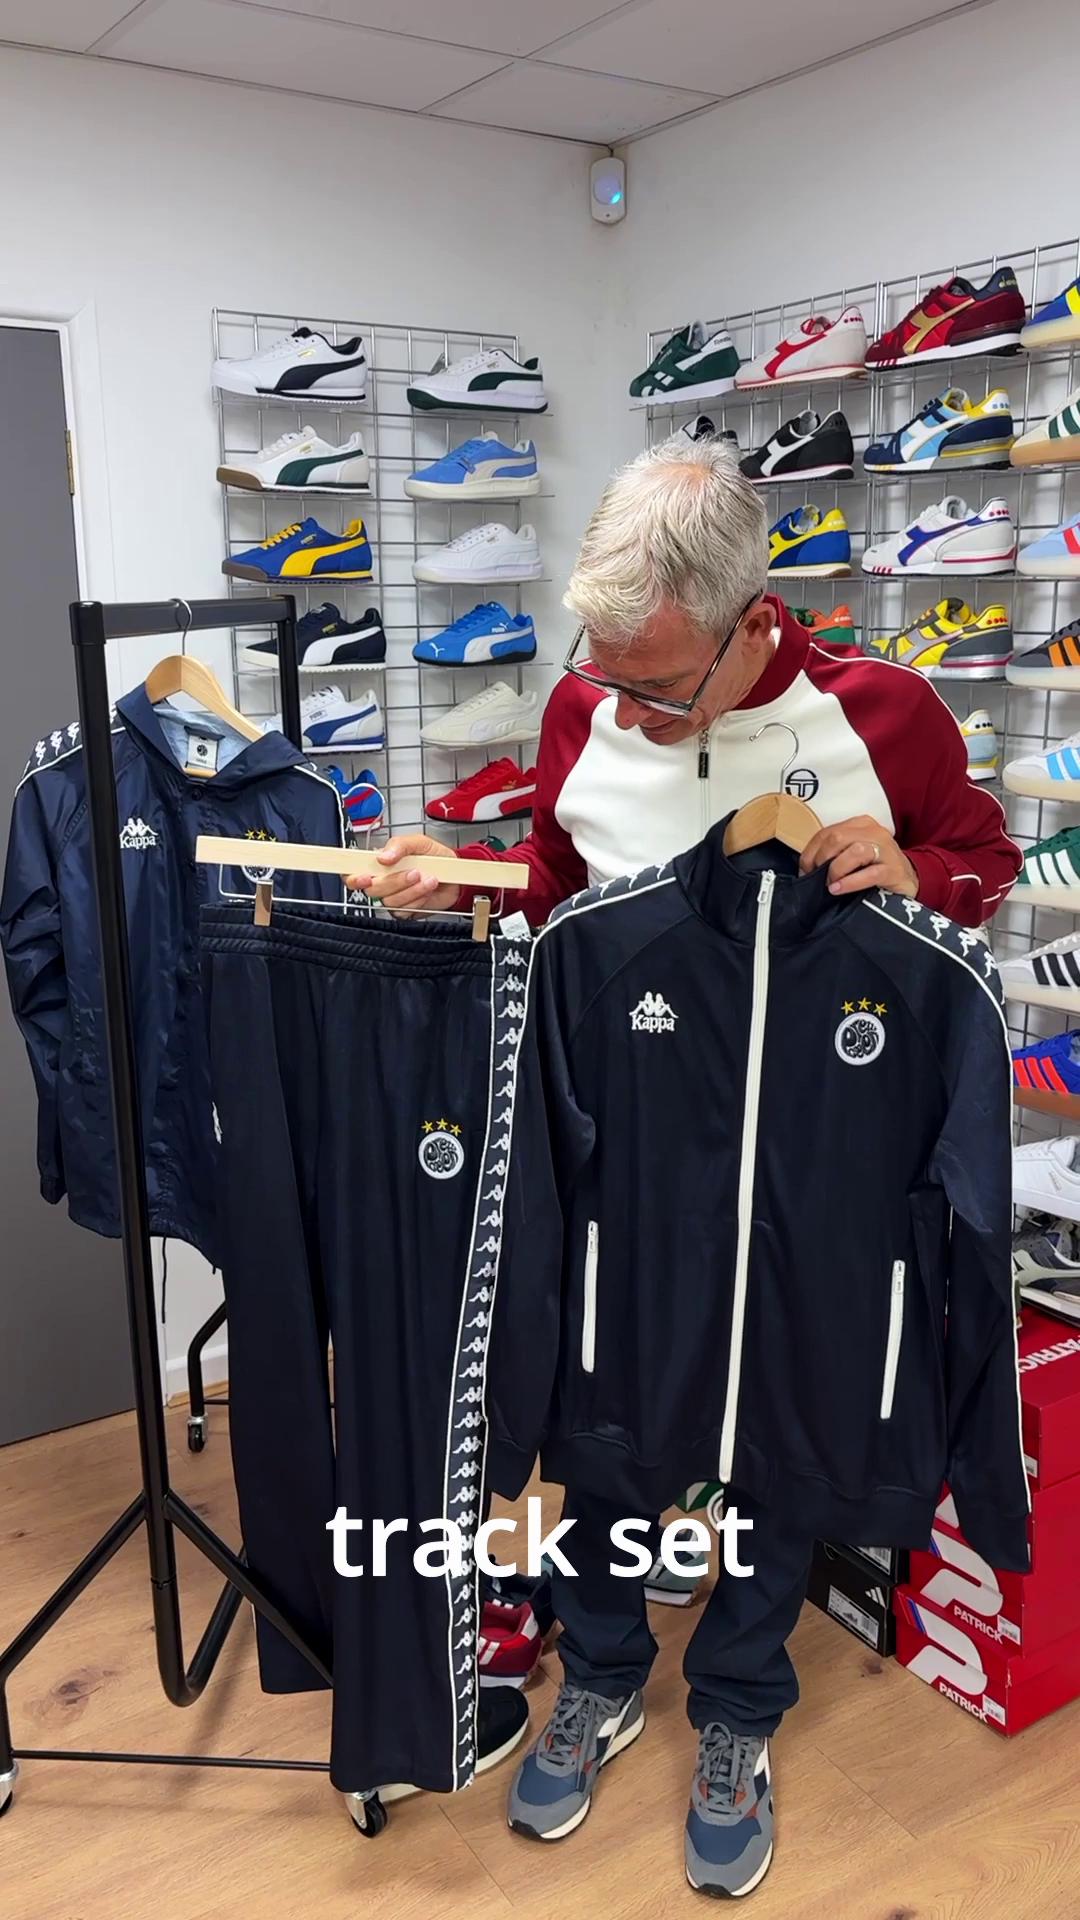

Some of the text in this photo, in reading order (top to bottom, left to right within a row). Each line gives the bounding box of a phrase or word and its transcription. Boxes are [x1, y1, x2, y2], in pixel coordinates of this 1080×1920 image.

[119, 835, 156, 850] Kappa
[631, 1014, 675, 1033] Kappa
[1018, 1334, 1080, 1374] ATRIC
[953, 1605, 1003, 1645] PATRICK
[939, 1682, 988, 1723] PATRICK
